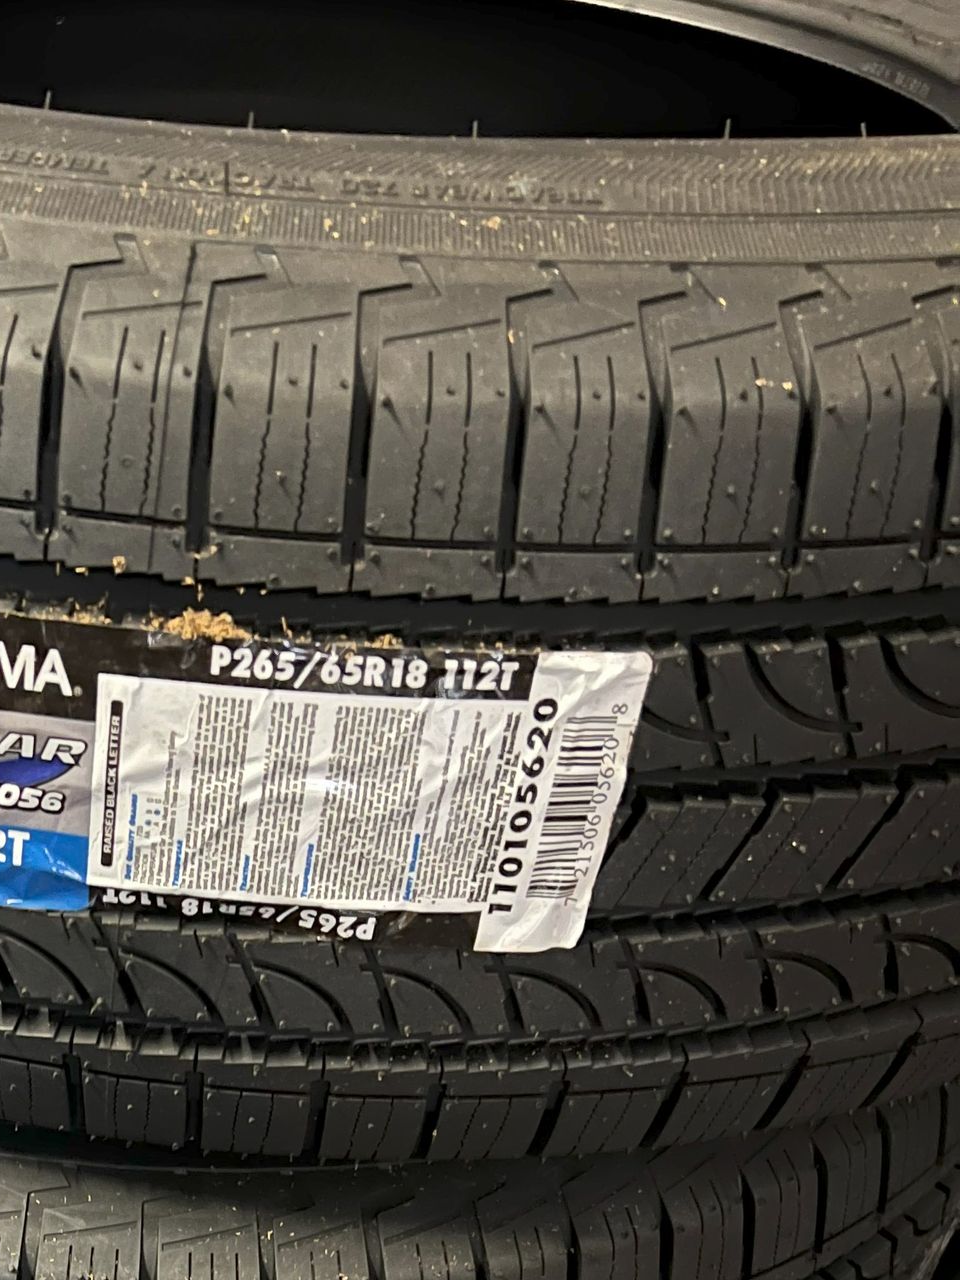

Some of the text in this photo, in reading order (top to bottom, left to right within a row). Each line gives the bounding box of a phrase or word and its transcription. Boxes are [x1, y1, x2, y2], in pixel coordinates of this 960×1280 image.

[210, 644, 519, 693] P265/65R18 112T
[104, 715, 120, 853] RAISED BLACK LETTER
[488, 698, 558, 914] 110105620
